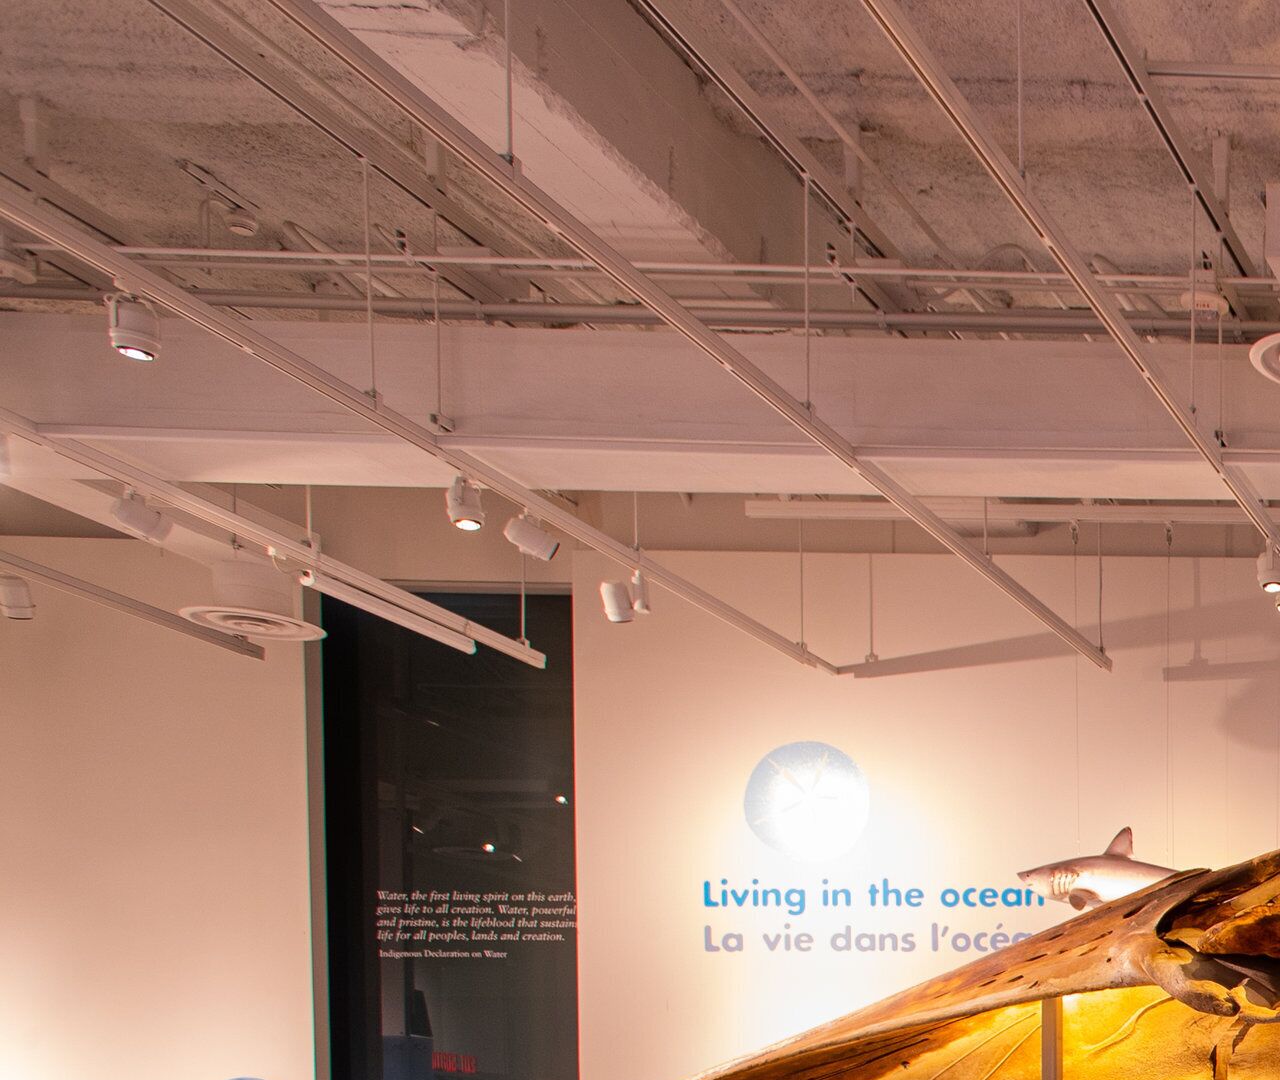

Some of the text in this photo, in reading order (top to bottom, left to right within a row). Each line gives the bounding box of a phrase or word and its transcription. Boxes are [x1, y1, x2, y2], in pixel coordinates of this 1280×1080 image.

[376, 890, 409, 901] Water,
[411, 890, 428, 901] the
[429, 890, 450, 903] first
[452, 890, 481, 904] living
[482, 891, 509, 903] spirit
[511, 894, 525, 902] on
[527, 891, 546, 902] this
[703, 877, 1045, 916] Living in the ocean
[375, 903, 577, 917] gives life to all creation. Water, powerful
[376, 916, 397, 927] and
[398, 917, 440, 930] pristine,
[441, 917, 451, 927] is
[452, 916, 469, 928] the
[470, 916, 516, 930] lifeblood
[517, 917, 538, 928] that
[376, 929, 566, 943] life for all peoples, lands and creation.
[704, 924, 744, 953] La
[762, 922, 814, 952] vie
[830, 924, 916, 953] dans
[379, 948, 508, 960] Indigenous Declaration on Water
